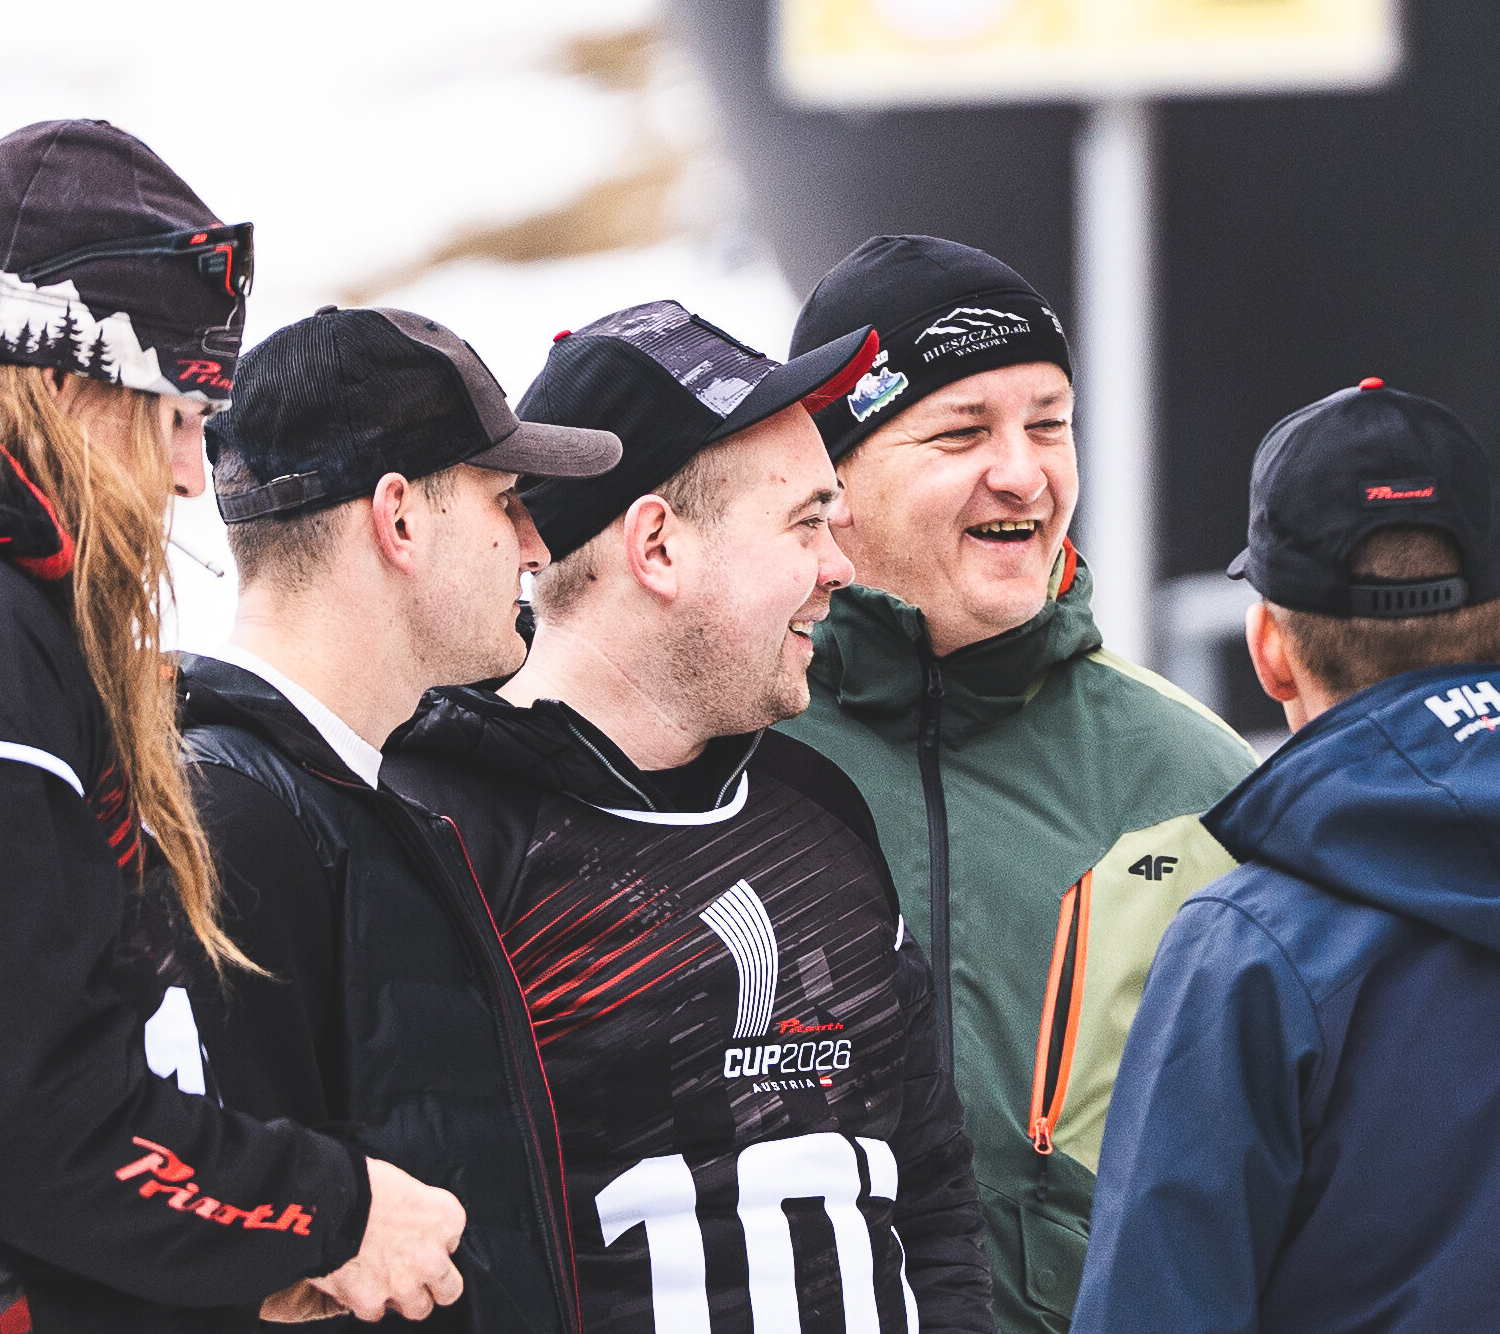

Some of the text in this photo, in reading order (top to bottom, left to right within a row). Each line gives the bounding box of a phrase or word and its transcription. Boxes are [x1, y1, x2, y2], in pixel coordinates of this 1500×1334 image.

[923, 323, 1031, 363] BIESZCZAD.ski
[1128, 854, 1178, 881] 4F
[752, 1078, 816, 1094] AUSTRIA
[115, 1136, 312, 1236] Prinoth
